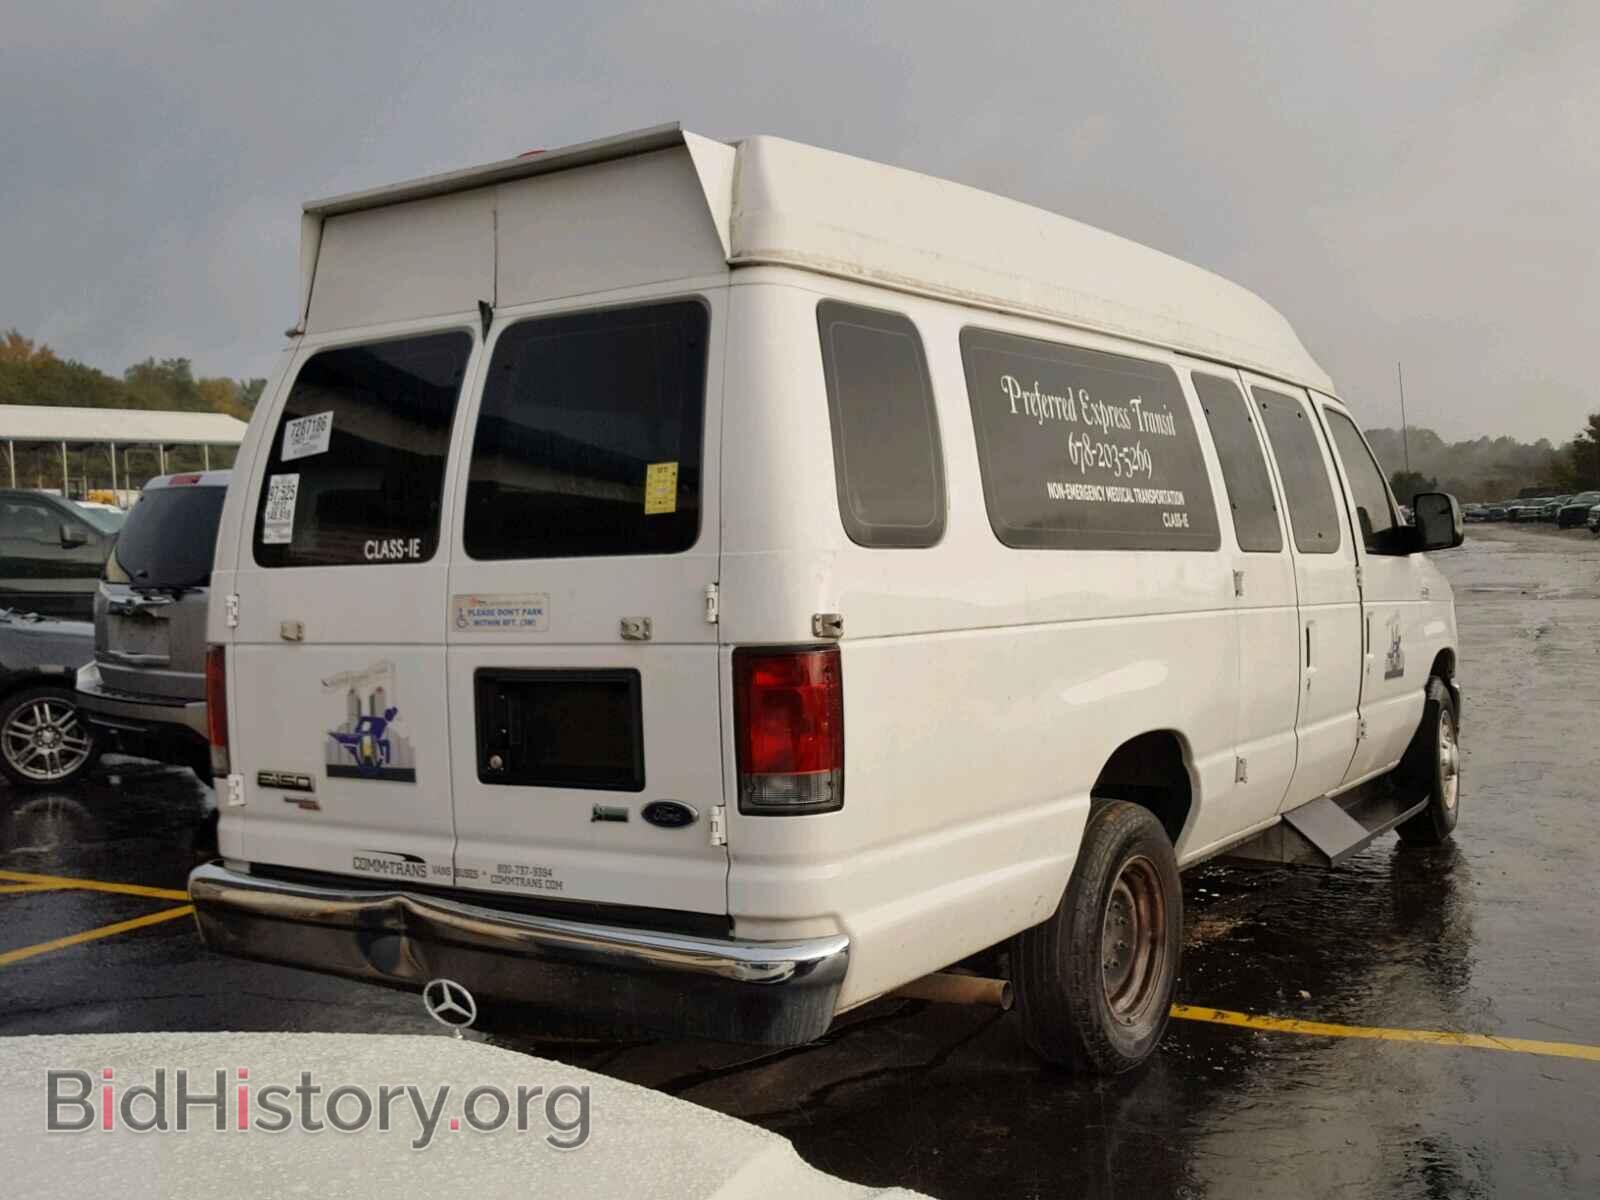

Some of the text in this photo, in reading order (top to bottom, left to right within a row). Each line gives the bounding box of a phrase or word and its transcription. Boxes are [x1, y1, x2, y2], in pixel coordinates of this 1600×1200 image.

[1001, 375, 1177, 436] Preferred Express Transit
[1068, 432, 1152, 480] 678-203-5269
[1047, 482, 1185, 506] NON-EMERGENCY MEDICAL TRANSPORTATION
[364, 538, 422, 560] CLASS-IE
[468, 608, 497, 617] PLEASE
[521, 608, 544, 617] PARK
